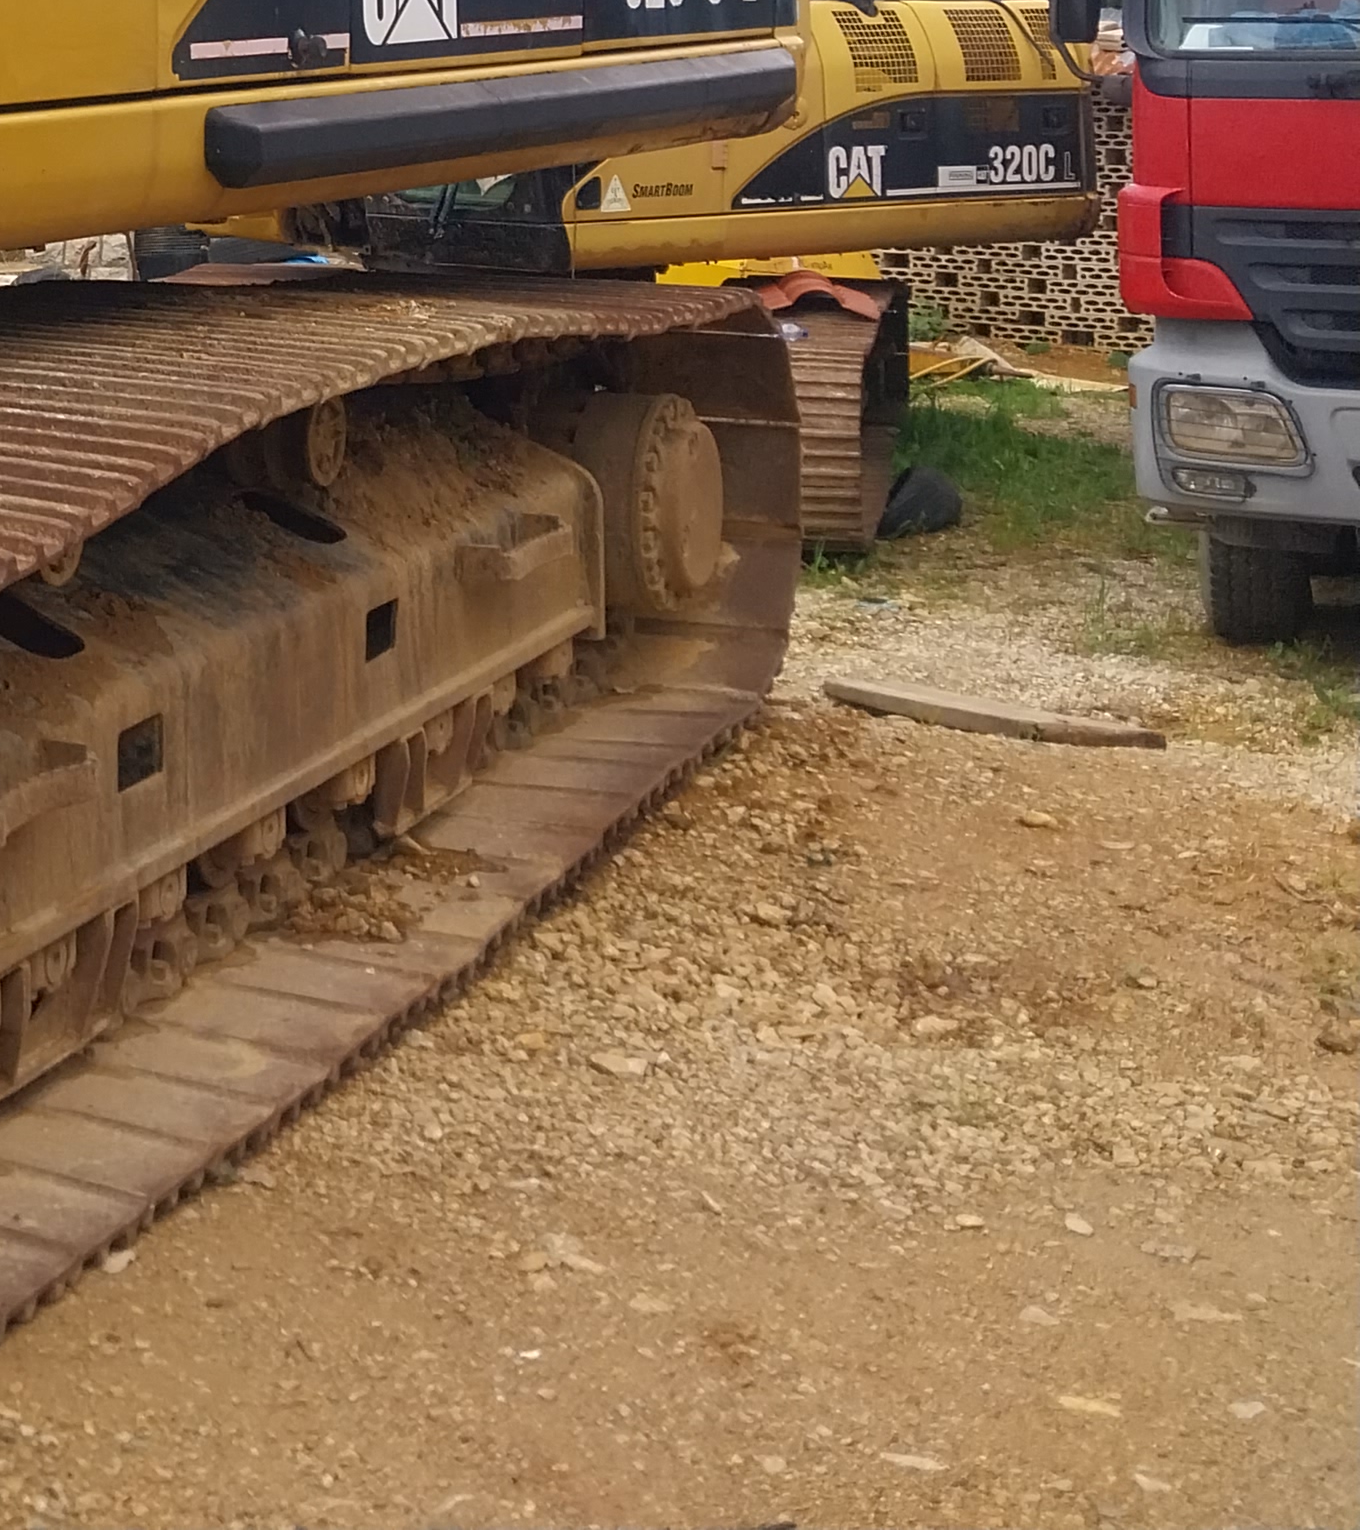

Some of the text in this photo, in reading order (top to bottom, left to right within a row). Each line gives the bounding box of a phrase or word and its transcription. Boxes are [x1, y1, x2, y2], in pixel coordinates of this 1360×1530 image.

[828, 146, 885, 198] CAT
[988, 143, 1076, 183] 320C L
